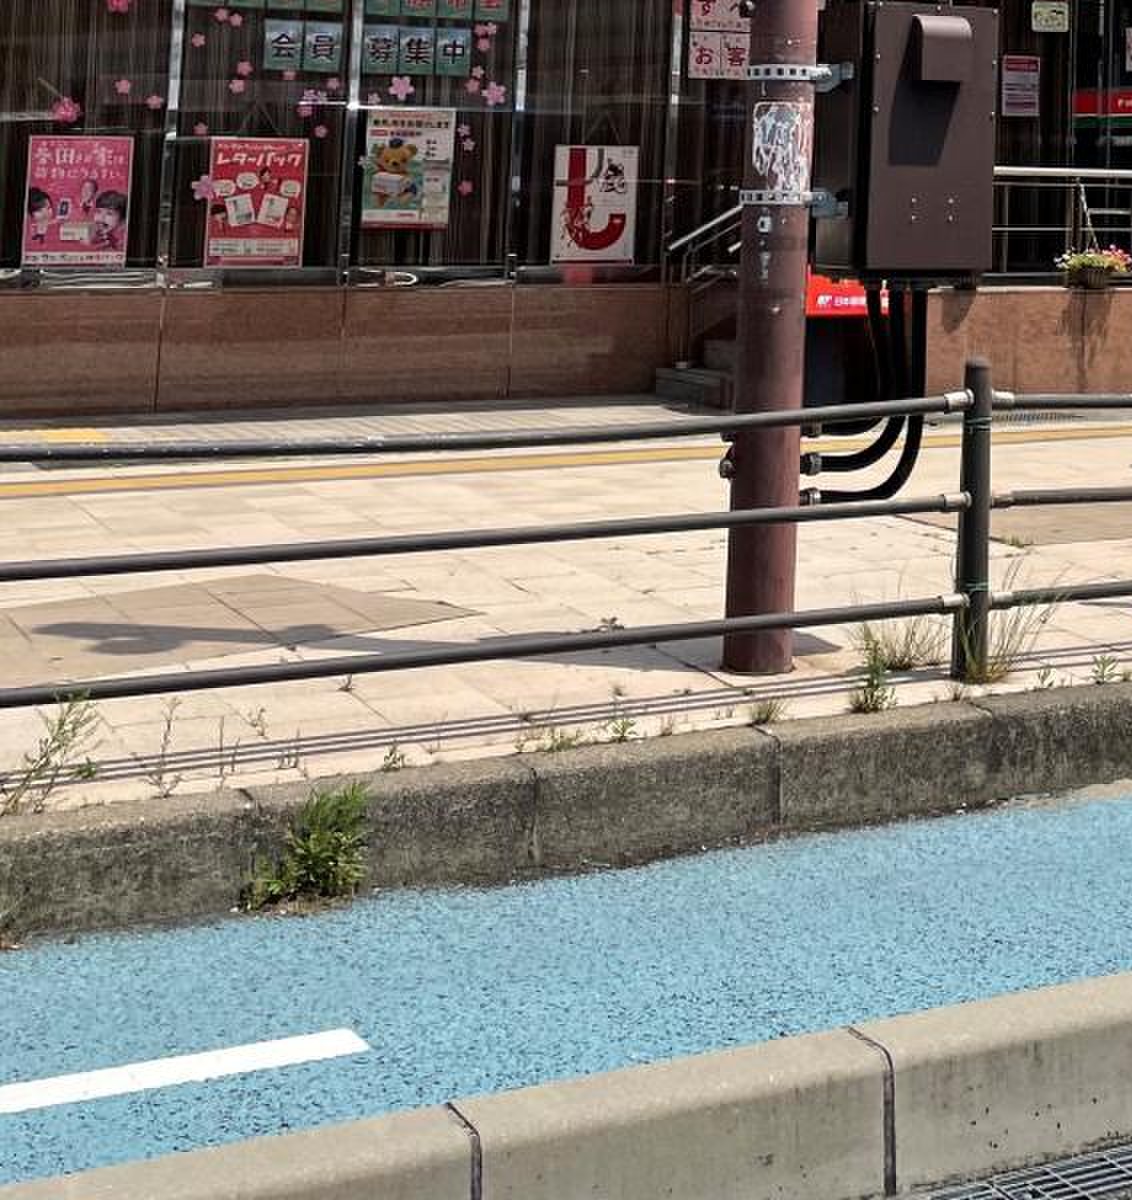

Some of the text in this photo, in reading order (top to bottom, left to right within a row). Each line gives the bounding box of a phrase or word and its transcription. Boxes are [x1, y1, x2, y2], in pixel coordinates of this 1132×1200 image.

[270, 33, 466, 67] 会員募集中
